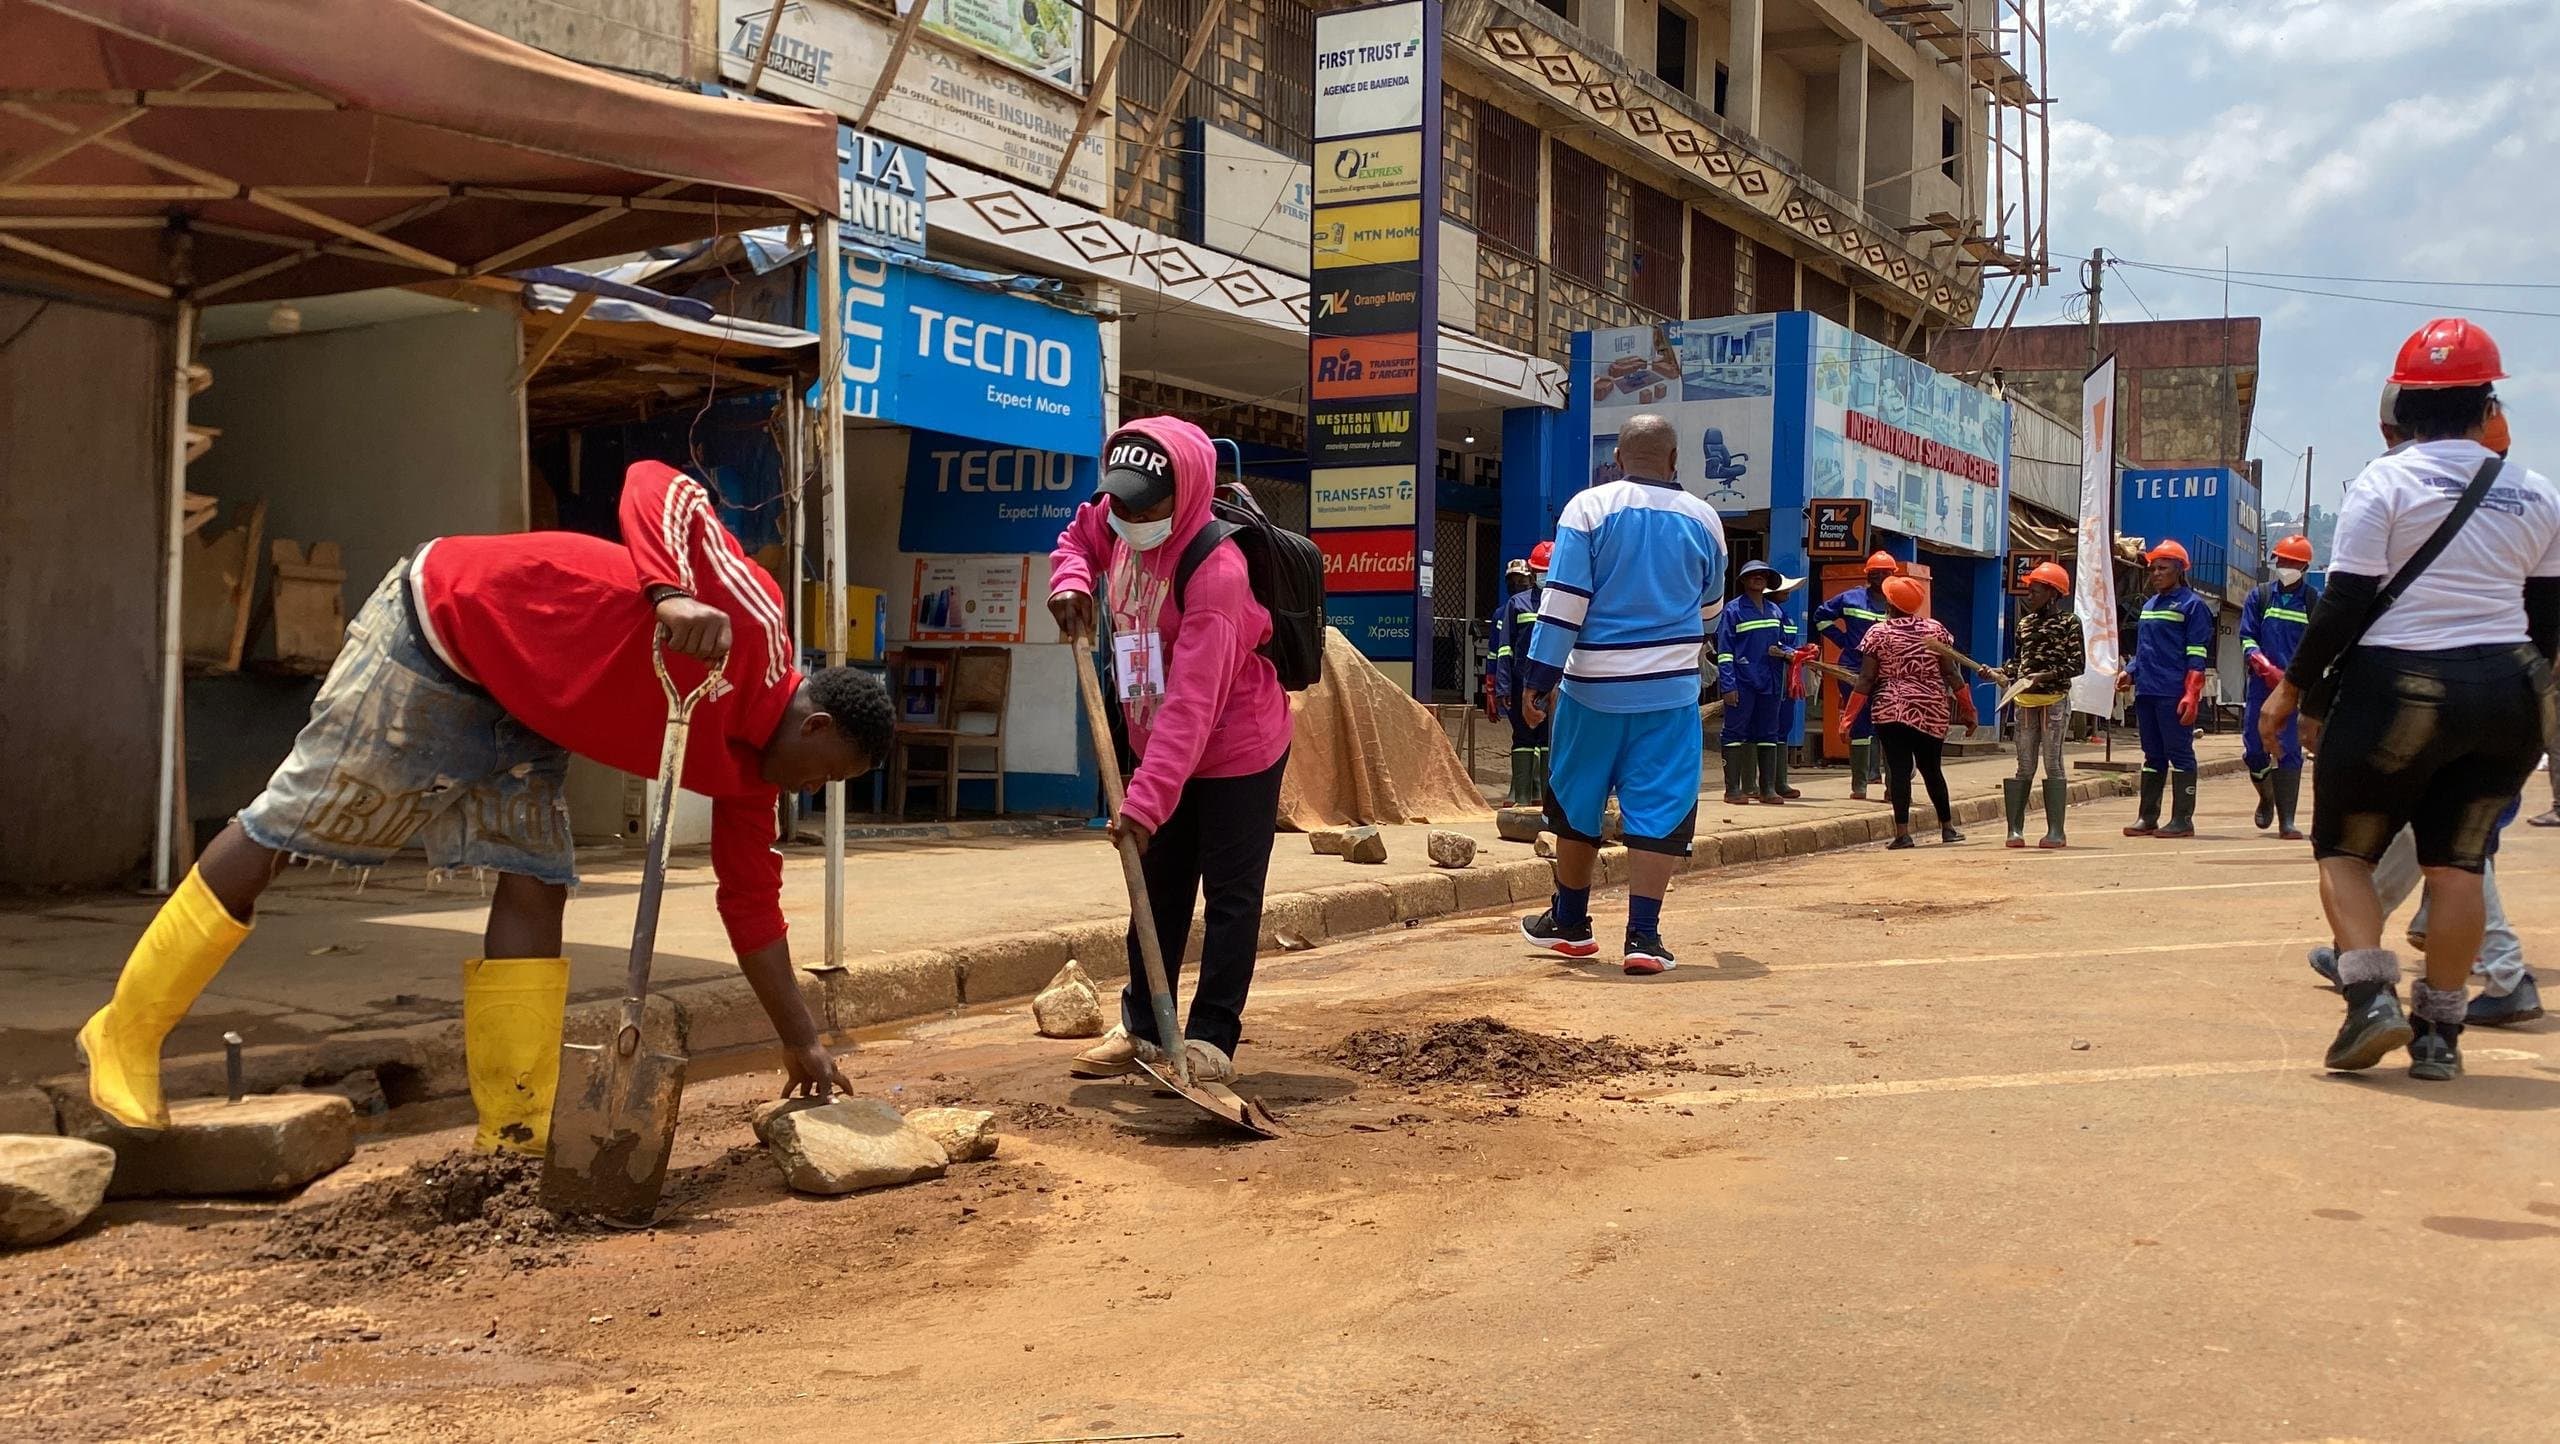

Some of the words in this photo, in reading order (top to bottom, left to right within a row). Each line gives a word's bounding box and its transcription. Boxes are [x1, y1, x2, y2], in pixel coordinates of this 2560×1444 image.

[1319, 49, 1355, 70] FIRST
[1358, 42, 1401, 64] TRUST
[1323, 82, 1356, 97] AGENCE
[1357, 81, 1369, 92] DE
[1370, 75, 1410, 90] BAMENDA
[930, 75, 996, 115] ZENITHE
[999, 102, 1073, 144] INSURANC
[945, 103, 996, 129] COMMERCIAL
[998, 123, 1028, 142] AVENUE
[1359, 165, 1404, 180] EXPRESS
[1282, 203, 1310, 223] FIRST
[1354, 228, 1382, 242] MTN
[1354, 294, 1386, 307] Orange
[1387, 291, 1417, 303] Money
[909, 305, 1072, 387] TECNO
[1317, 347, 1363, 383] Ria
[1369, 358, 1416, 368] TRANSFERT
[1369, 368, 1416, 380] D'ARGENT
[987, 384, 1032, 409] Expect
[1035, 395, 1071, 416] More
[1316, 412, 1372, 425] WESTERN
[1377, 410, 1410, 434] WU
[1333, 423, 1372, 436] UNION
[1325, 442, 1349, 451] moving
[1349, 441, 1371, 451] money
[1371, 440, 1381, 449] for
[1382, 440, 1402, 448] better
[1848, 410, 1922, 463] INTERNATIONAL
[1923, 438, 1969, 477] SHOPPING
[1108, 444, 1168, 476] DIOR
[931, 451, 1074, 493] TECNO
[1315, 486, 1394, 503] TRANSFAST
[2135, 476, 2218, 499] TECNO
[999, 503, 1039, 523] Expect
[1041, 503, 1072, 518] More
[1819, 532, 1846, 540] Money
[1820, 523, 1848, 533] Orange
[1322, 553, 1343, 574] BA
[1346, 550, 1415, 574] Africash
[1378, 616, 1410, 625] POINT
